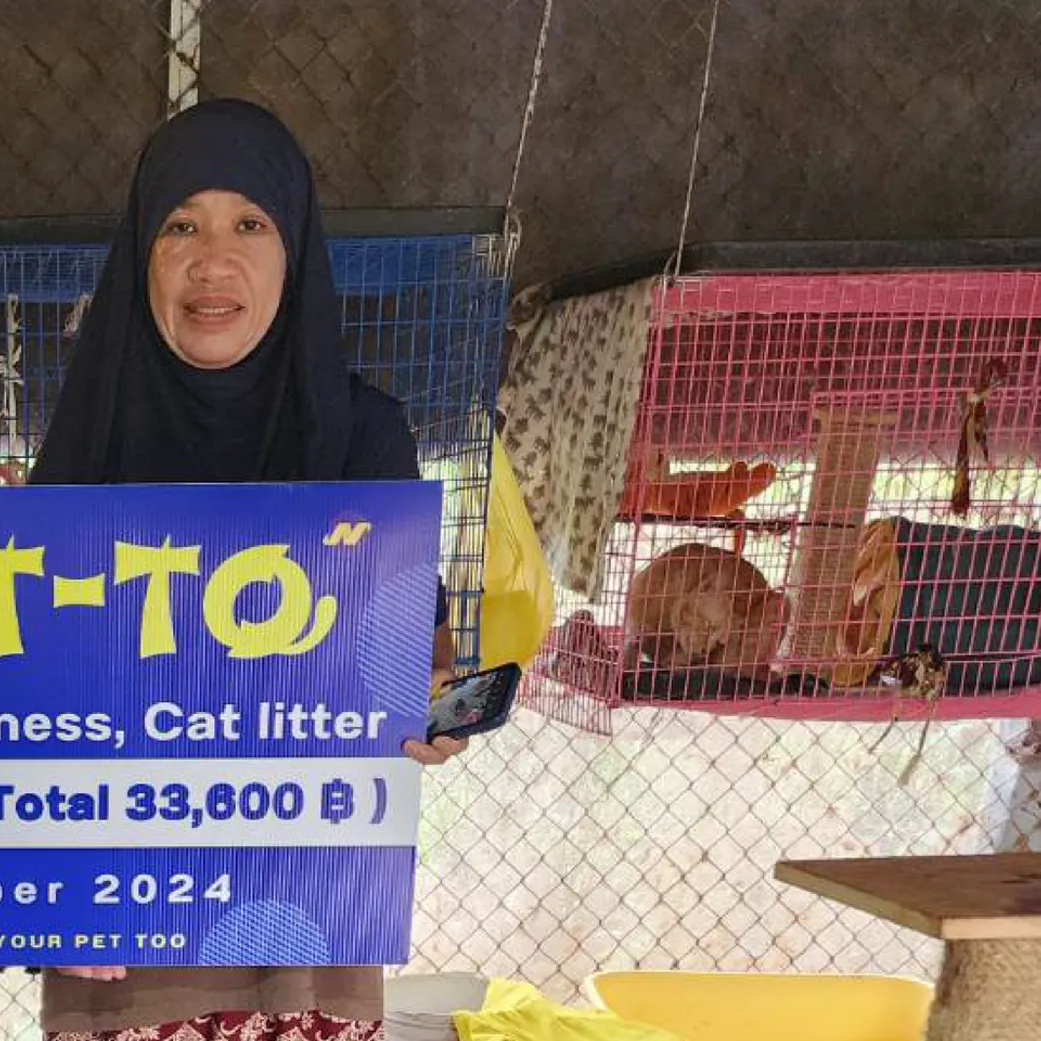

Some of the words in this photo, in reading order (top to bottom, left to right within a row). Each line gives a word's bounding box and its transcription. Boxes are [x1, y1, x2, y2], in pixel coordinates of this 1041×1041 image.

[144, 701, 241, 741] Cat
[259, 701, 388, 740] litter
[125, 781, 305, 828] 33,600
[92, 873, 232, 904] 2024
[74, 933, 123, 949] PET
[134, 933, 187, 949] TOO
